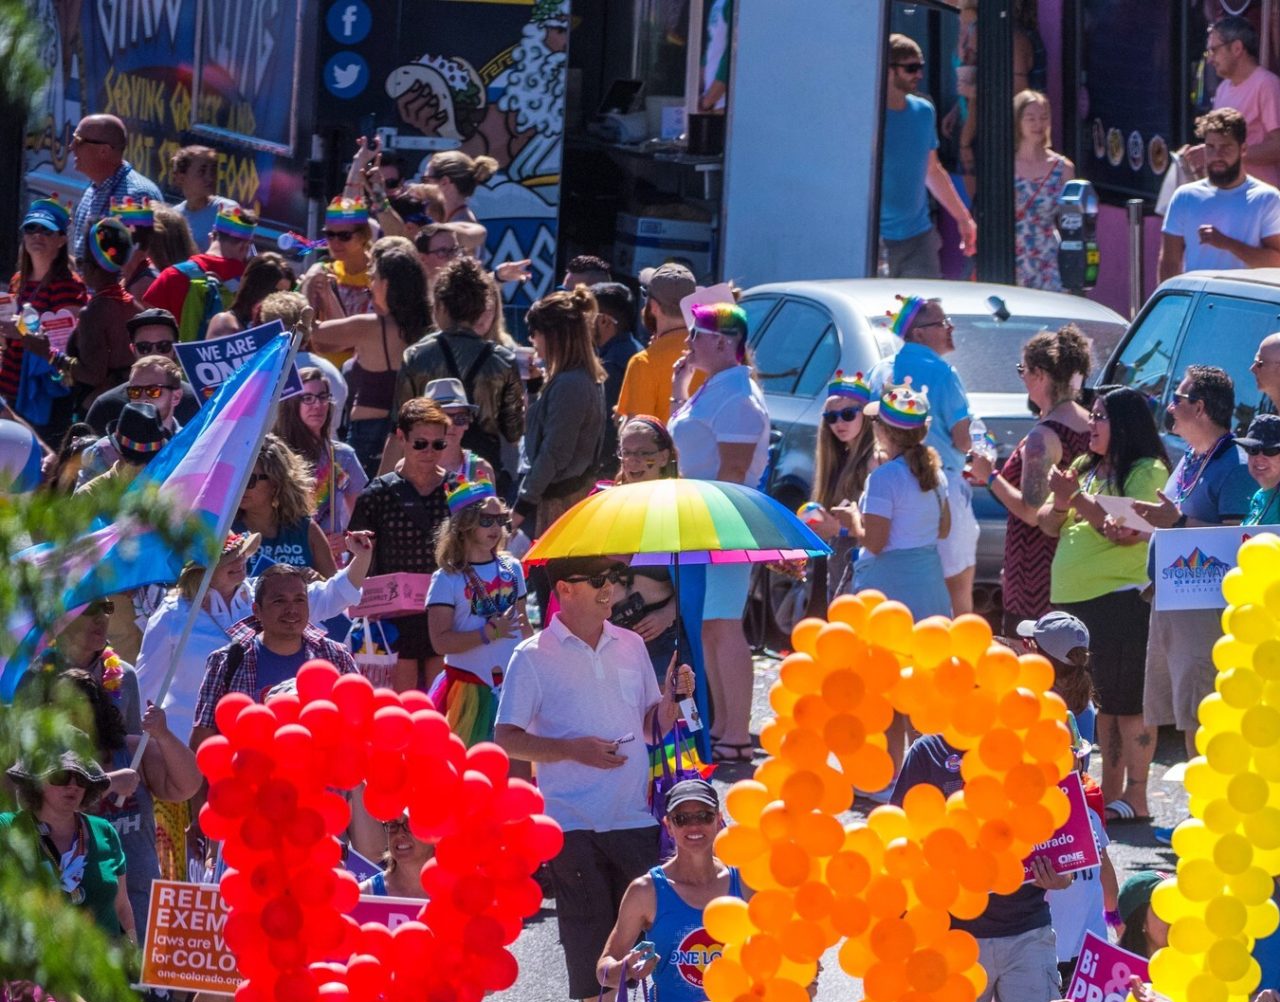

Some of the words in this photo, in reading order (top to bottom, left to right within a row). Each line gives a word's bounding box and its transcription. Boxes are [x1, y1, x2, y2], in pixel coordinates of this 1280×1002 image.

[196, 345, 221, 361] WE
[226, 335, 257, 357] ARE
[1058, 851, 1085, 864] ONE
[153, 929, 184, 949] laws
[187, 938, 211, 949] are
[152, 949, 171, 965] for
[173, 950, 239, 972] COLO
[1080, 948, 1099, 979] Bi
